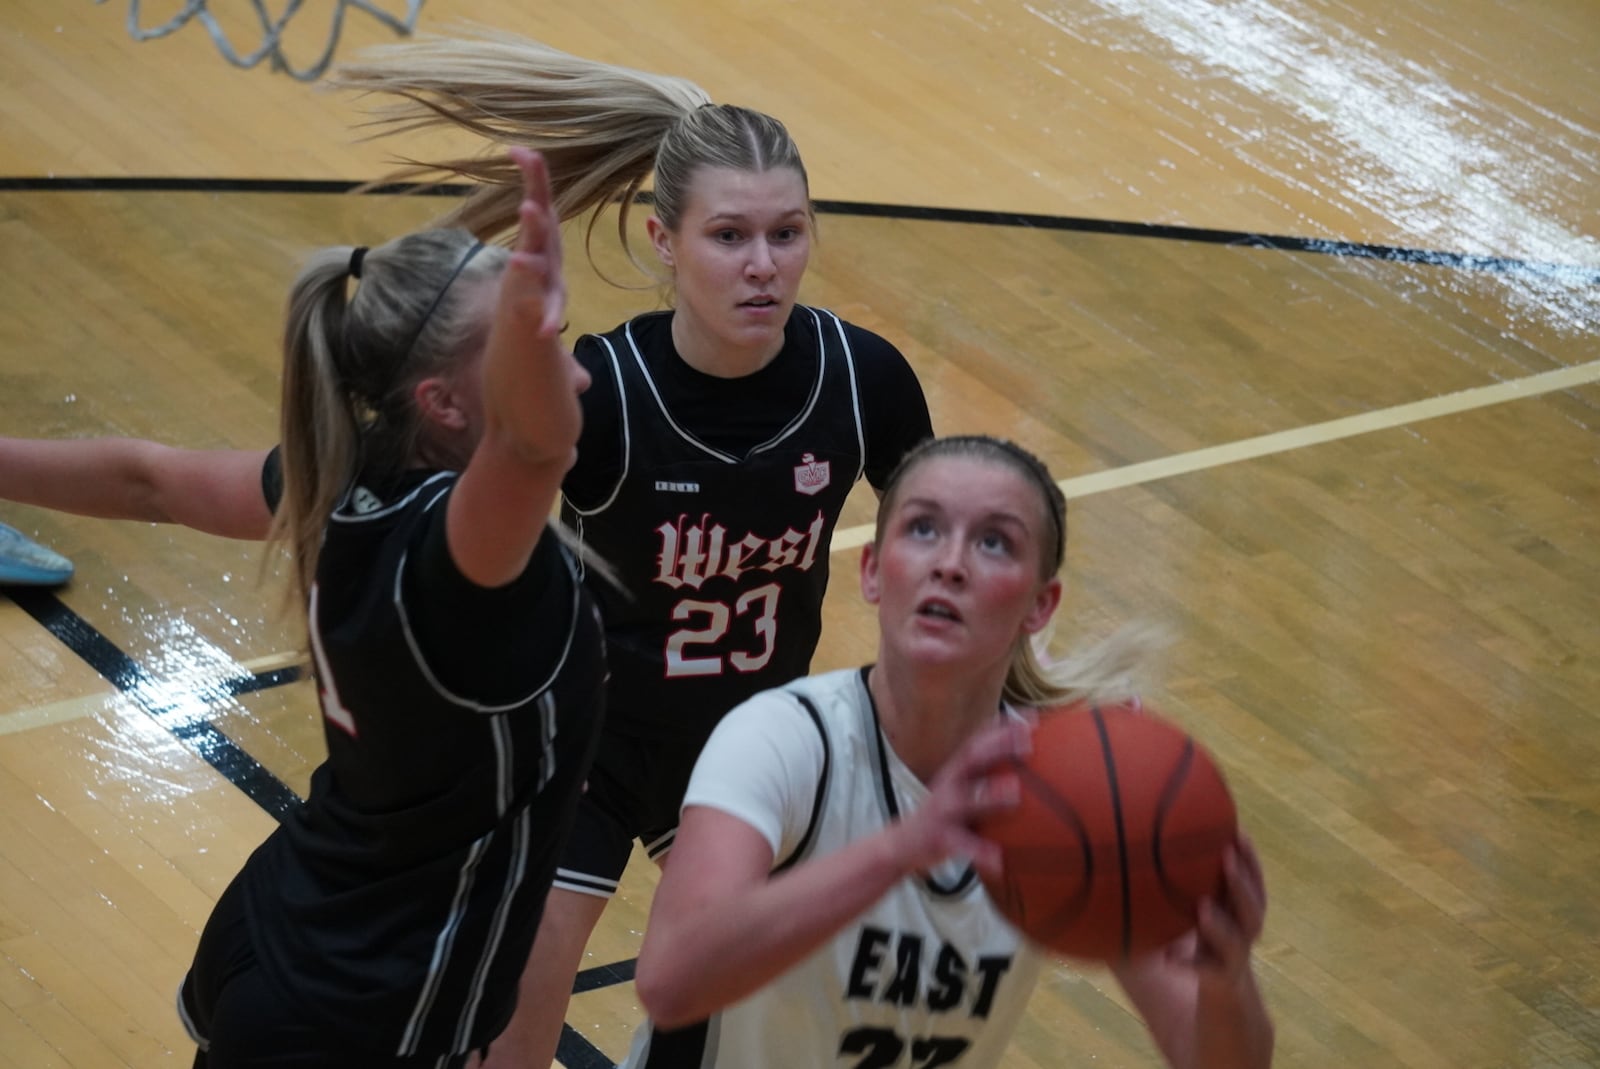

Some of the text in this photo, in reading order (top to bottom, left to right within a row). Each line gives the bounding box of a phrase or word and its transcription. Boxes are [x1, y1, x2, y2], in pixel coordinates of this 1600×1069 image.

[653, 510, 825, 589] West
[665, 583, 782, 677] 23
[845, 926, 1013, 1019] EAST
